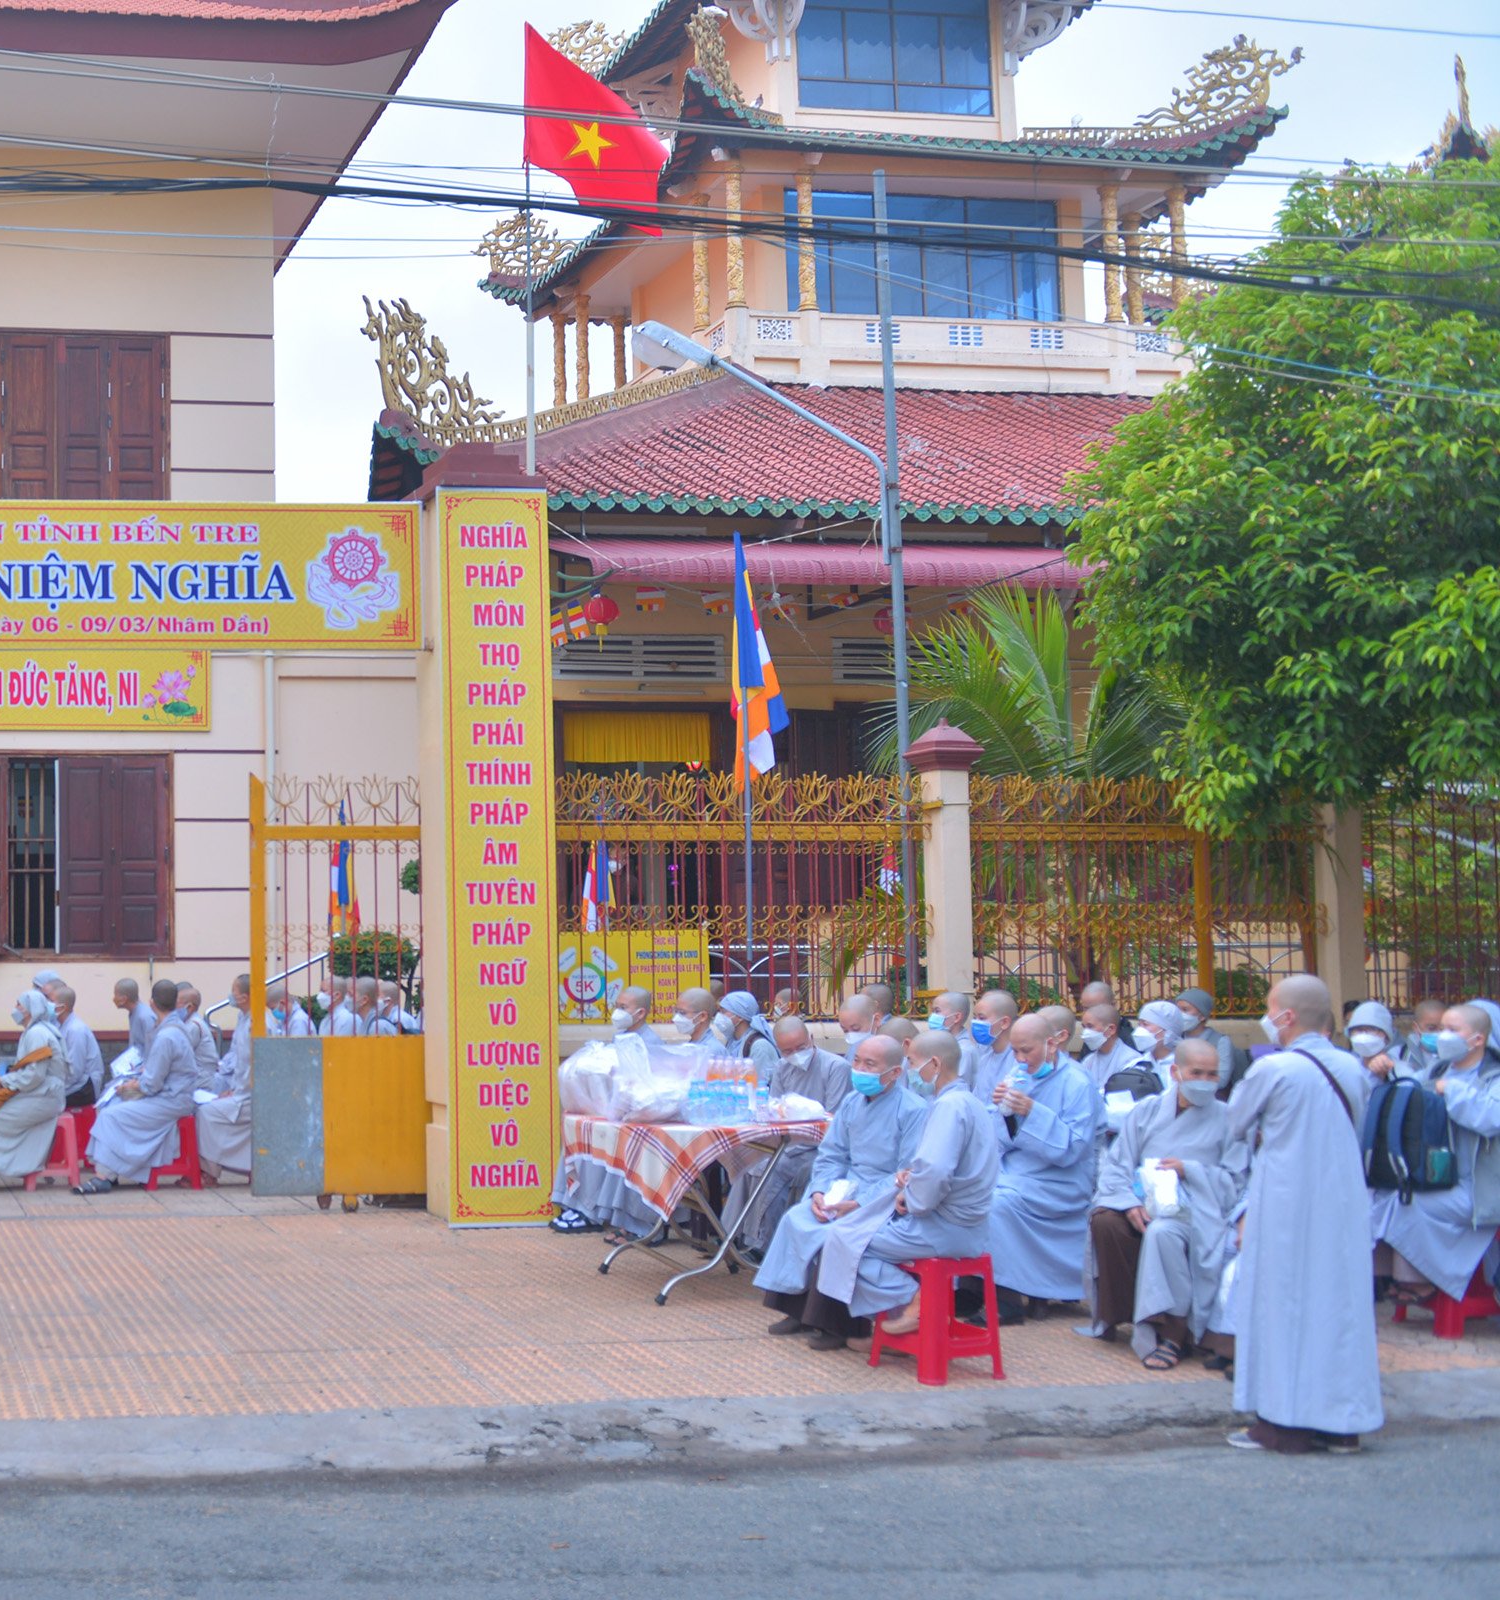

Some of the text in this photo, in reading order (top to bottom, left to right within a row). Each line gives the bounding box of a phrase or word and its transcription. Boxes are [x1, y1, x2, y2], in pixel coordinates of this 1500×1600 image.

[15, 516, 99, 543] TỈNH
[112, 516, 181, 543] BẾN
[192, 524, 258, 543] TRE
[130, 552, 295, 602] NGHĨA
[32, 616, 59, 633] 06
[80, 615, 215, 635] 09/03/Nhâm
[223, 614, 270, 635] Dần)
[8, 661, 49, 706] ĐỨC
[55, 663, 112, 713] TĂNG,
[119, 672, 138, 706] NI
[460, 521, 540, 1188] NGHĨA PHÁP MÔN THỌ PHÁP PHÁI THÍNH PHÁP ÂM TUYÊN PHÁP NGỮ VÔ LƯỢNG DIỆC VÔ NGHĨA
[576, 981, 594, 993] 5K
